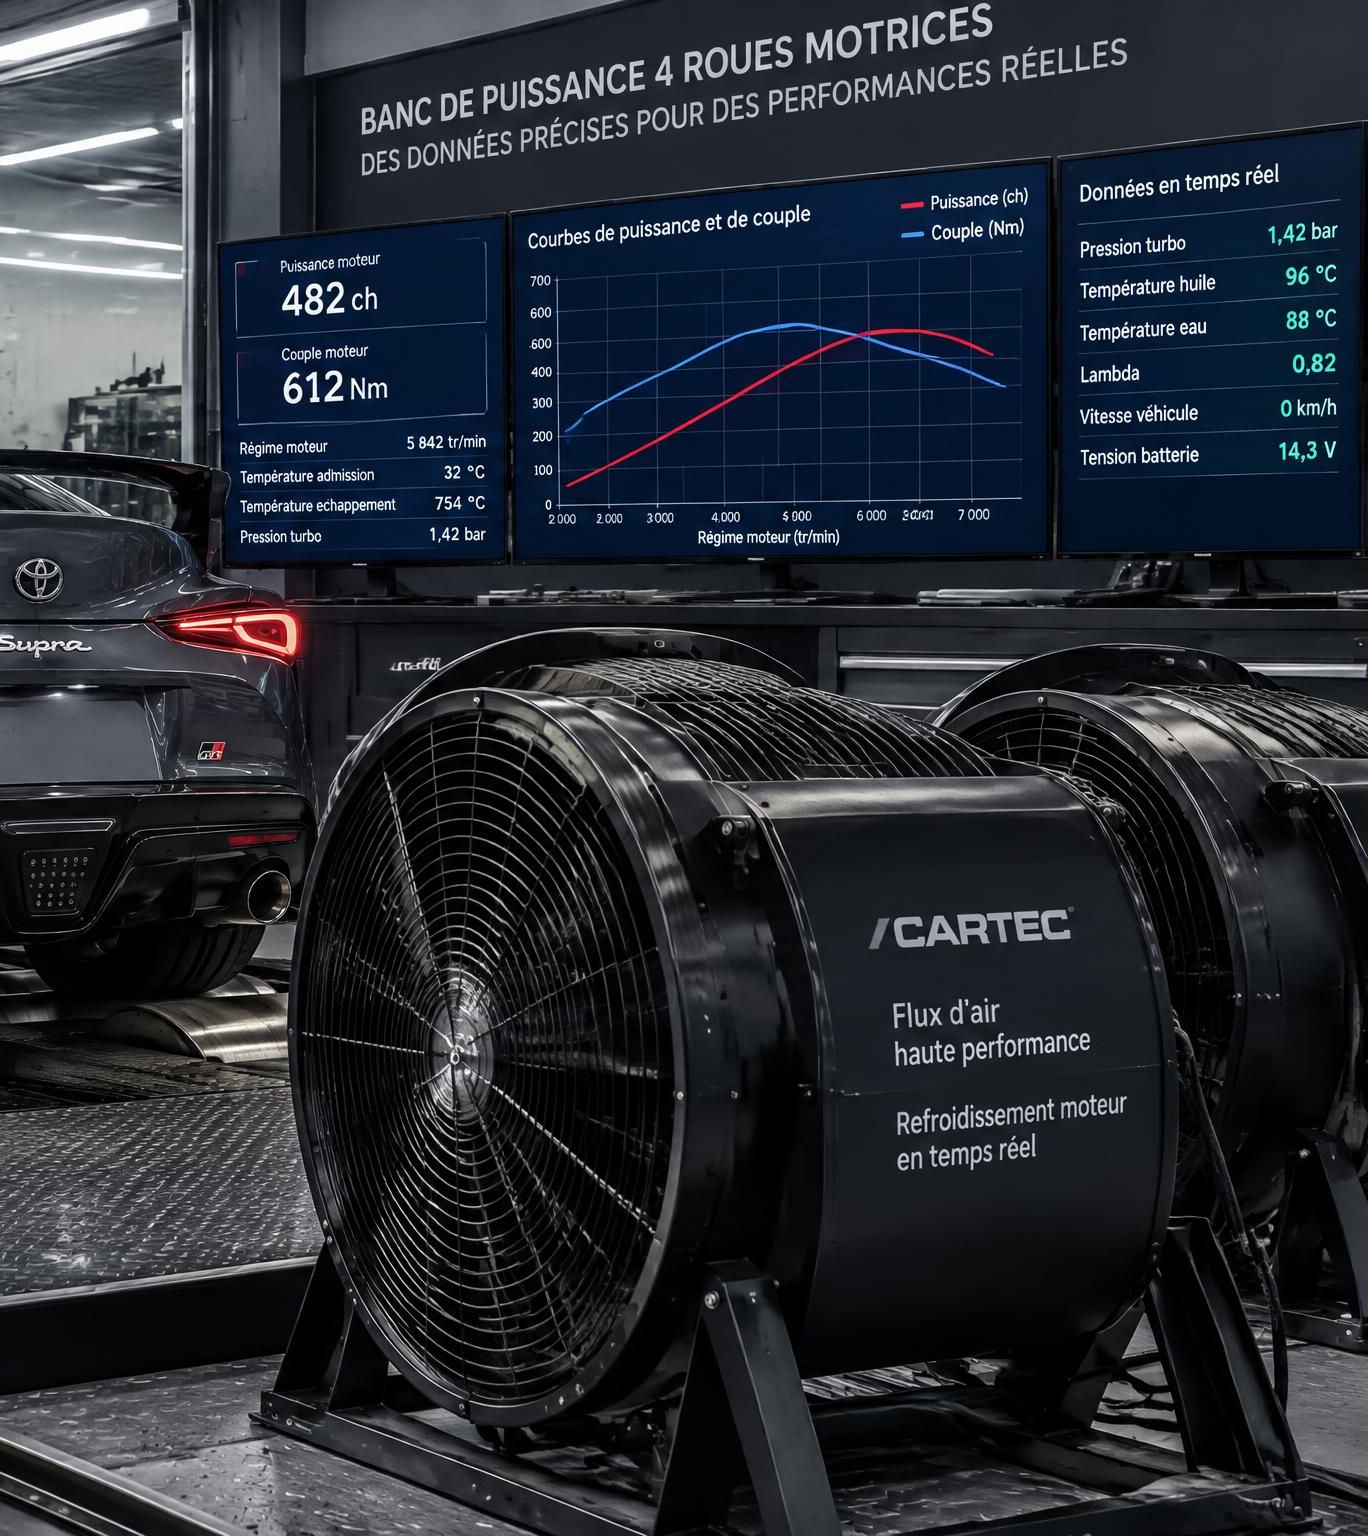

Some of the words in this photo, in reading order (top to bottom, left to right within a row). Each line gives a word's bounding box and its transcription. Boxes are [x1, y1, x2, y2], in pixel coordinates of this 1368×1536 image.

[362, 97, 432, 135] BANC
[441, 88, 473, 121] DE
[482, 59, 646, 115] PUISSANCE
[655, 56, 673, 86] 4
[685, 36, 793, 82] ROUES
[806, 2, 993, 65] MOTRICES
[362, 149, 400, 176] DES
[408, 129, 512, 169] DONNÉES
[521, 113, 628, 152] PRÉCISES
[638, 102, 703, 134] POUR
[713, 93, 759, 123] DES
[768, 59, 991, 116] PERFORMANCES
[1002, 38, 1127, 82] RÉELLES
[1080, 179, 1154, 202] Données
[1159, 179, 1179, 194] en
[1185, 173, 1240, 192] temps
[1246, 163, 1279, 185] réel
[931, 194, 998, 210] Puissance
[1003, 187, 1028, 207] (ch)
[528, 229, 590, 249] Courbes
[595, 224, 614, 242] de
[620, 219, 700, 244] puissance
[706, 214, 722, 230] et
[727, 210, 748, 228] de
[753, 205, 810, 227] couple
[932, 222, 983, 242] Couple
[989, 218, 1024, 239] (Nm)
[1268, 223, 1305, 246] 1,42
[1312, 222, 1338, 239] bar
[1081, 238, 1141, 258] Pression
[1146, 235, 1185, 252] turbo
[281, 259, 334, 272] Puissance
[338, 254, 380, 268] moteur
[531, 275, 550, 286] 700
[1286, 266, 1309, 285] 96
[1316, 264, 1336, 282] °C
[1080, 279, 1175, 301] Température
[1180, 274, 1215, 292] huile
[282, 282, 344, 316] 482
[352, 286, 377, 310] ch
[531, 307, 551, 318] 600
[1287, 311, 1308, 329] 88
[1316, 309, 1336, 327] °C
[1080, 322, 1175, 343] Température
[1180, 322, 1206, 335] eau
[282, 347, 322, 363] Couple
[326, 345, 368, 358] moteur
[531, 367, 552, 377] 400
[1081, 364, 1139, 383] Lambda
[1293, 353, 1336, 375] 0,82
[284, 370, 343, 404] 612
[351, 377, 387, 400] Nm
[533, 397, 552, 408] 300
[1281, 400, 1292, 417] 0
[1298, 398, 1336, 417] km/h
[1080, 408, 1132, 424] Vitesse
[448, 435, 486, 449] tr/min
[533, 431, 552, 442] 200
[240, 441, 283, 457] Régime
[287, 441, 328, 453] moteur
[1081, 448, 1136, 465] Tension
[1142, 445, 1199, 463] batterie
[1279, 441, 1317, 462] 14,3
[1324, 441, 1336, 458] V
[240, 470, 313, 486] Température
[317, 469, 374, 482] admission
[445, 466, 460, 479] 32
[468, 465, 484, 479] °C
[535, 465, 552, 475] 100
[240, 499, 313, 515] Température
[435, 496, 462, 510] 754
[468, 496, 485, 509] °C
[546, 500, 551, 510] 0
[241, 530, 287, 543] Pression
[430, 527, 459, 543] 1,42
[465, 527, 486, 541] bar
[747, 531, 791, 543] moteur
[794, 529, 839, 546] (tr/min)
[893, 1003, 942, 1028] Flux
[895, 1041, 955, 1066] haute
[963, 1033, 1090, 1067] performance
[898, 1099, 1054, 1135] Refroidissement
[1061, 1095, 1127, 1119] moteur
[898, 1152, 922, 1170] en
[929, 1145, 992, 1170] temps
[1000, 1133, 1036, 1160] réel
